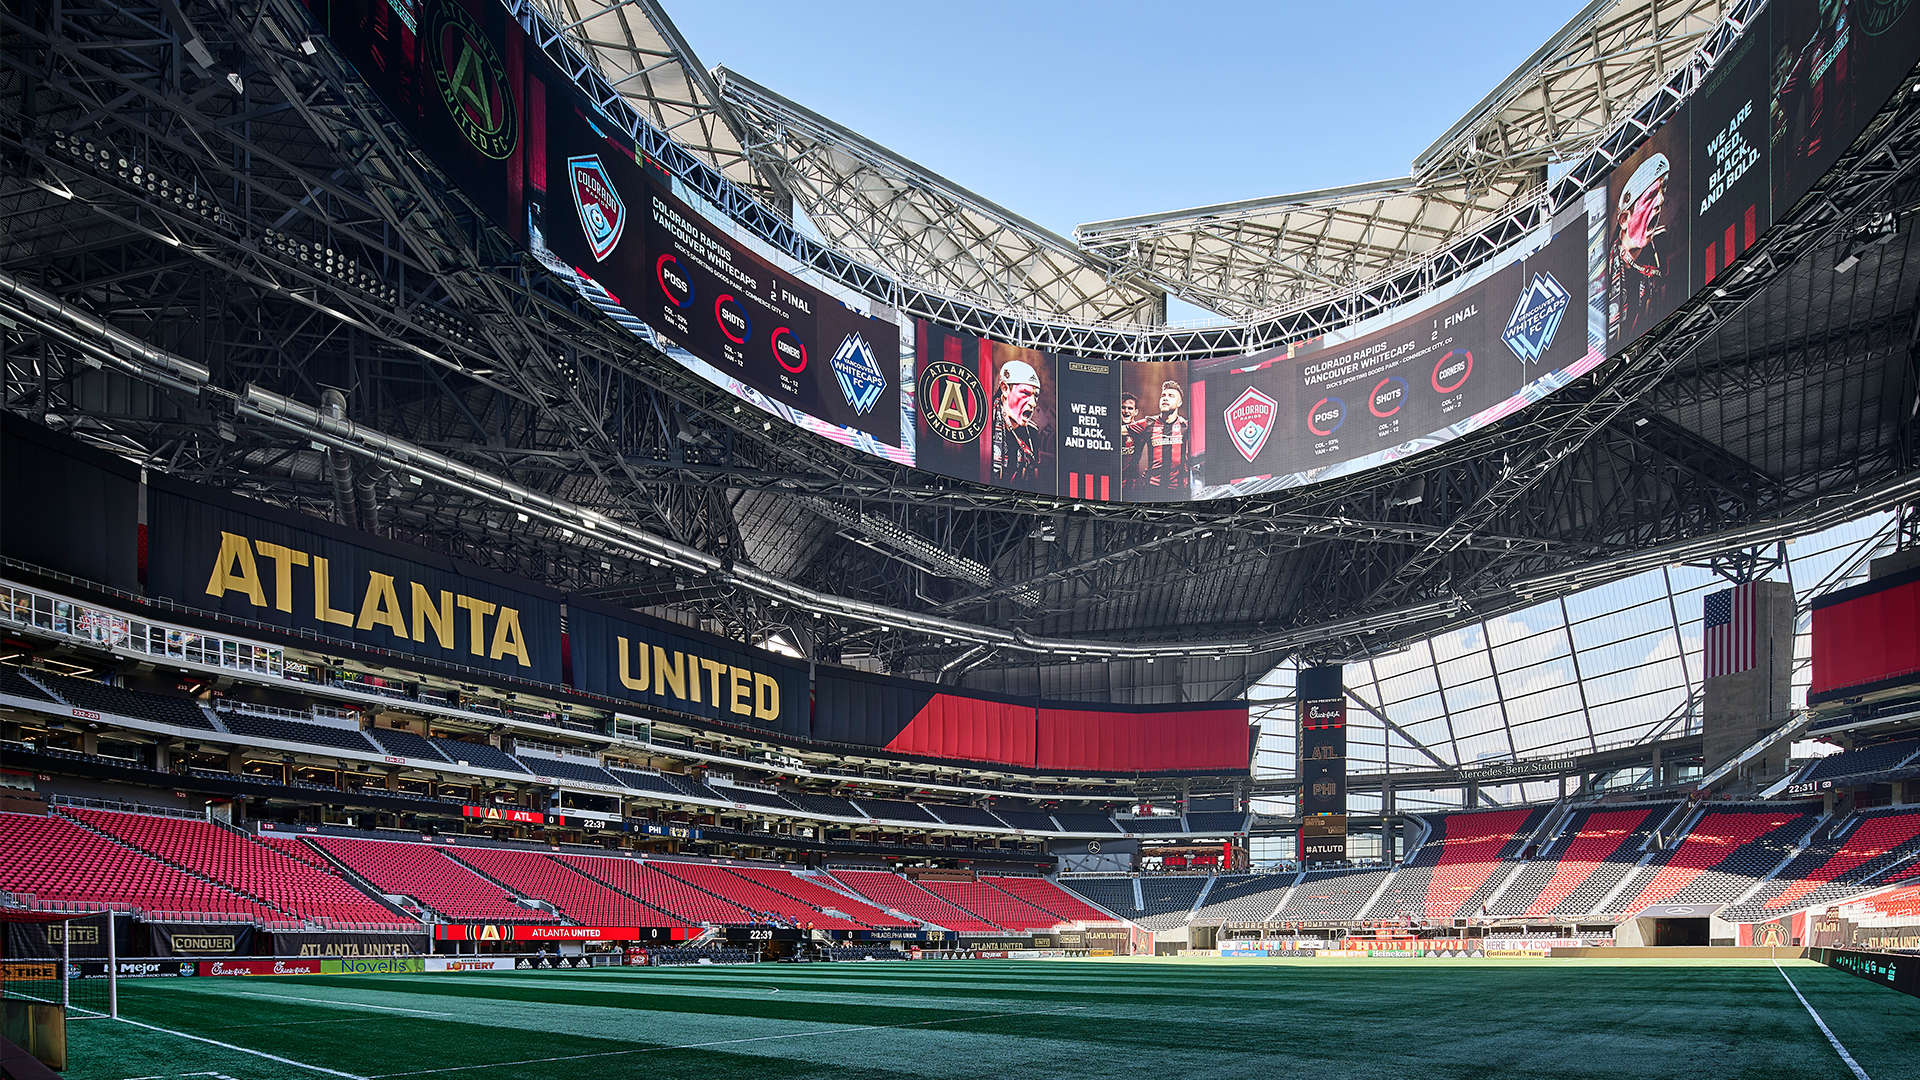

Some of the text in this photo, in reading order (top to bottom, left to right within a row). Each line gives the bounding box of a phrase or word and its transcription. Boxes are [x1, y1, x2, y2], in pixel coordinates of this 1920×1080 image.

[1707, 99, 1752, 157] WE ARE
[1717, 132, 1743, 166] RED,
[1709, 139, 1750, 190] BLACK,
[1700, 148, 1760, 216] AND BOLD.
[577, 170, 617, 214] COLORADO
[652, 196, 698, 239] COLORADO
[700, 232, 732, 262] RAPIDS
[653, 208, 757, 290] VANCOUVER WHITECAPS
[664, 268, 688, 293] POSS
[772, 280, 776, 290] 1
[770, 290, 777, 301] 2
[782, 289, 811, 314] FINAL
[1518, 296, 1555, 322] VANCOUVER
[722, 308, 745, 330] SHOTS
[1444, 304, 1479, 329] FINAL
[1506, 296, 1566, 338] WHITECAPS
[1434, 319, 1437, 329] 1
[1530, 322, 1542, 336] FC
[1431, 330, 1438, 340] 2
[1304, 342, 1387, 376] COLORADO RAPIDS
[1304, 340, 1415, 386] VANCOUVER WHITECAPS
[834, 360, 882, 387] WHITECAPS
[929, 365, 978, 389] ATLANTA
[1439, 361, 1465, 380] CORNERS
[853, 377, 864, 388] FC
[1376, 388, 1401, 404] SHOTS
[1071, 403, 1107, 416] WE ARE
[1233, 405, 1269, 420] COLORADO
[1315, 409, 1339, 423] POSS
[927, 411, 980, 440] UNITED FC
[1079, 415, 1100, 428] RED,
[1072, 426, 1106, 440] BLACK,
[1065, 436, 1113, 451] AND BOLD.
[205, 531, 531, 667] ATLANTA
[617, 636, 780, 721] UNITED
[1312, 746, 1337, 759] ATL
[1459, 760, 1573, 780] Mercedes-Benz Stadium
[514, 810, 532, 821] ATL
[649, 826, 661, 835] PHI
[1306, 845, 1344, 853] #ATLUTD
[1228, 920, 1286, 929] RESURGENCE
[532, 928, 600, 937] ATLANTA UNITED
[652, 930, 657, 938] 0
[750, 930, 772, 940] 22:39
[175, 938, 231, 950] CONQUER
[300, 944, 409, 956] ATLANTA UNITED
[1486, 940, 1505, 949] HERE
[15, 968, 53, 976] TIRE
[121, 963, 160, 974] Mejor
[341, 959, 407, 973] Novelis
[447, 962, 494, 970] LOTTERY
